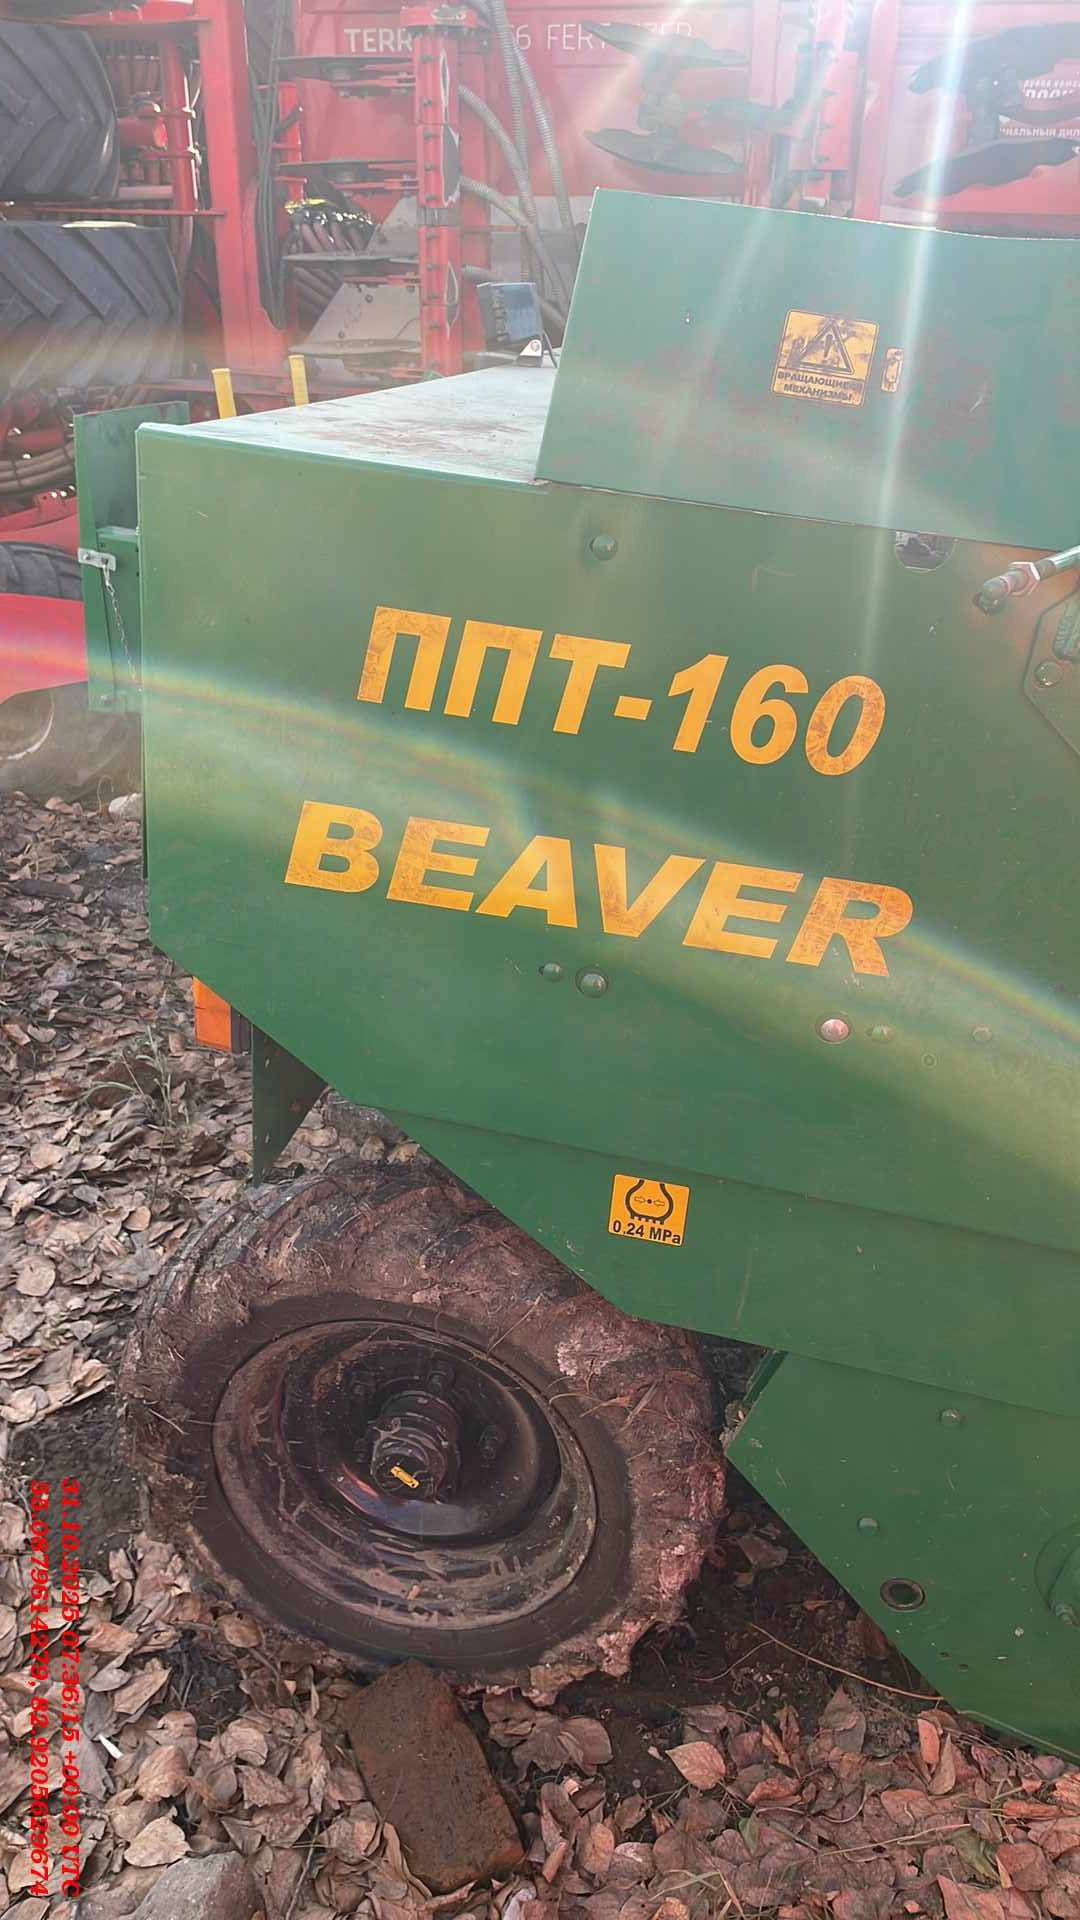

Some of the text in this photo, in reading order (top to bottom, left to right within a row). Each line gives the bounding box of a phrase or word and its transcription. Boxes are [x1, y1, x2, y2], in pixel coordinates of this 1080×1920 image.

[344, 28, 412, 53] TERR
[783, 383, 853, 401] МЕХАНИЗМЫ
[357, 606, 886, 776] ППТ-160
[284, 801, 914, 977] BEAVER
[612, 1219, 682, 1245] 0.24 MPa
